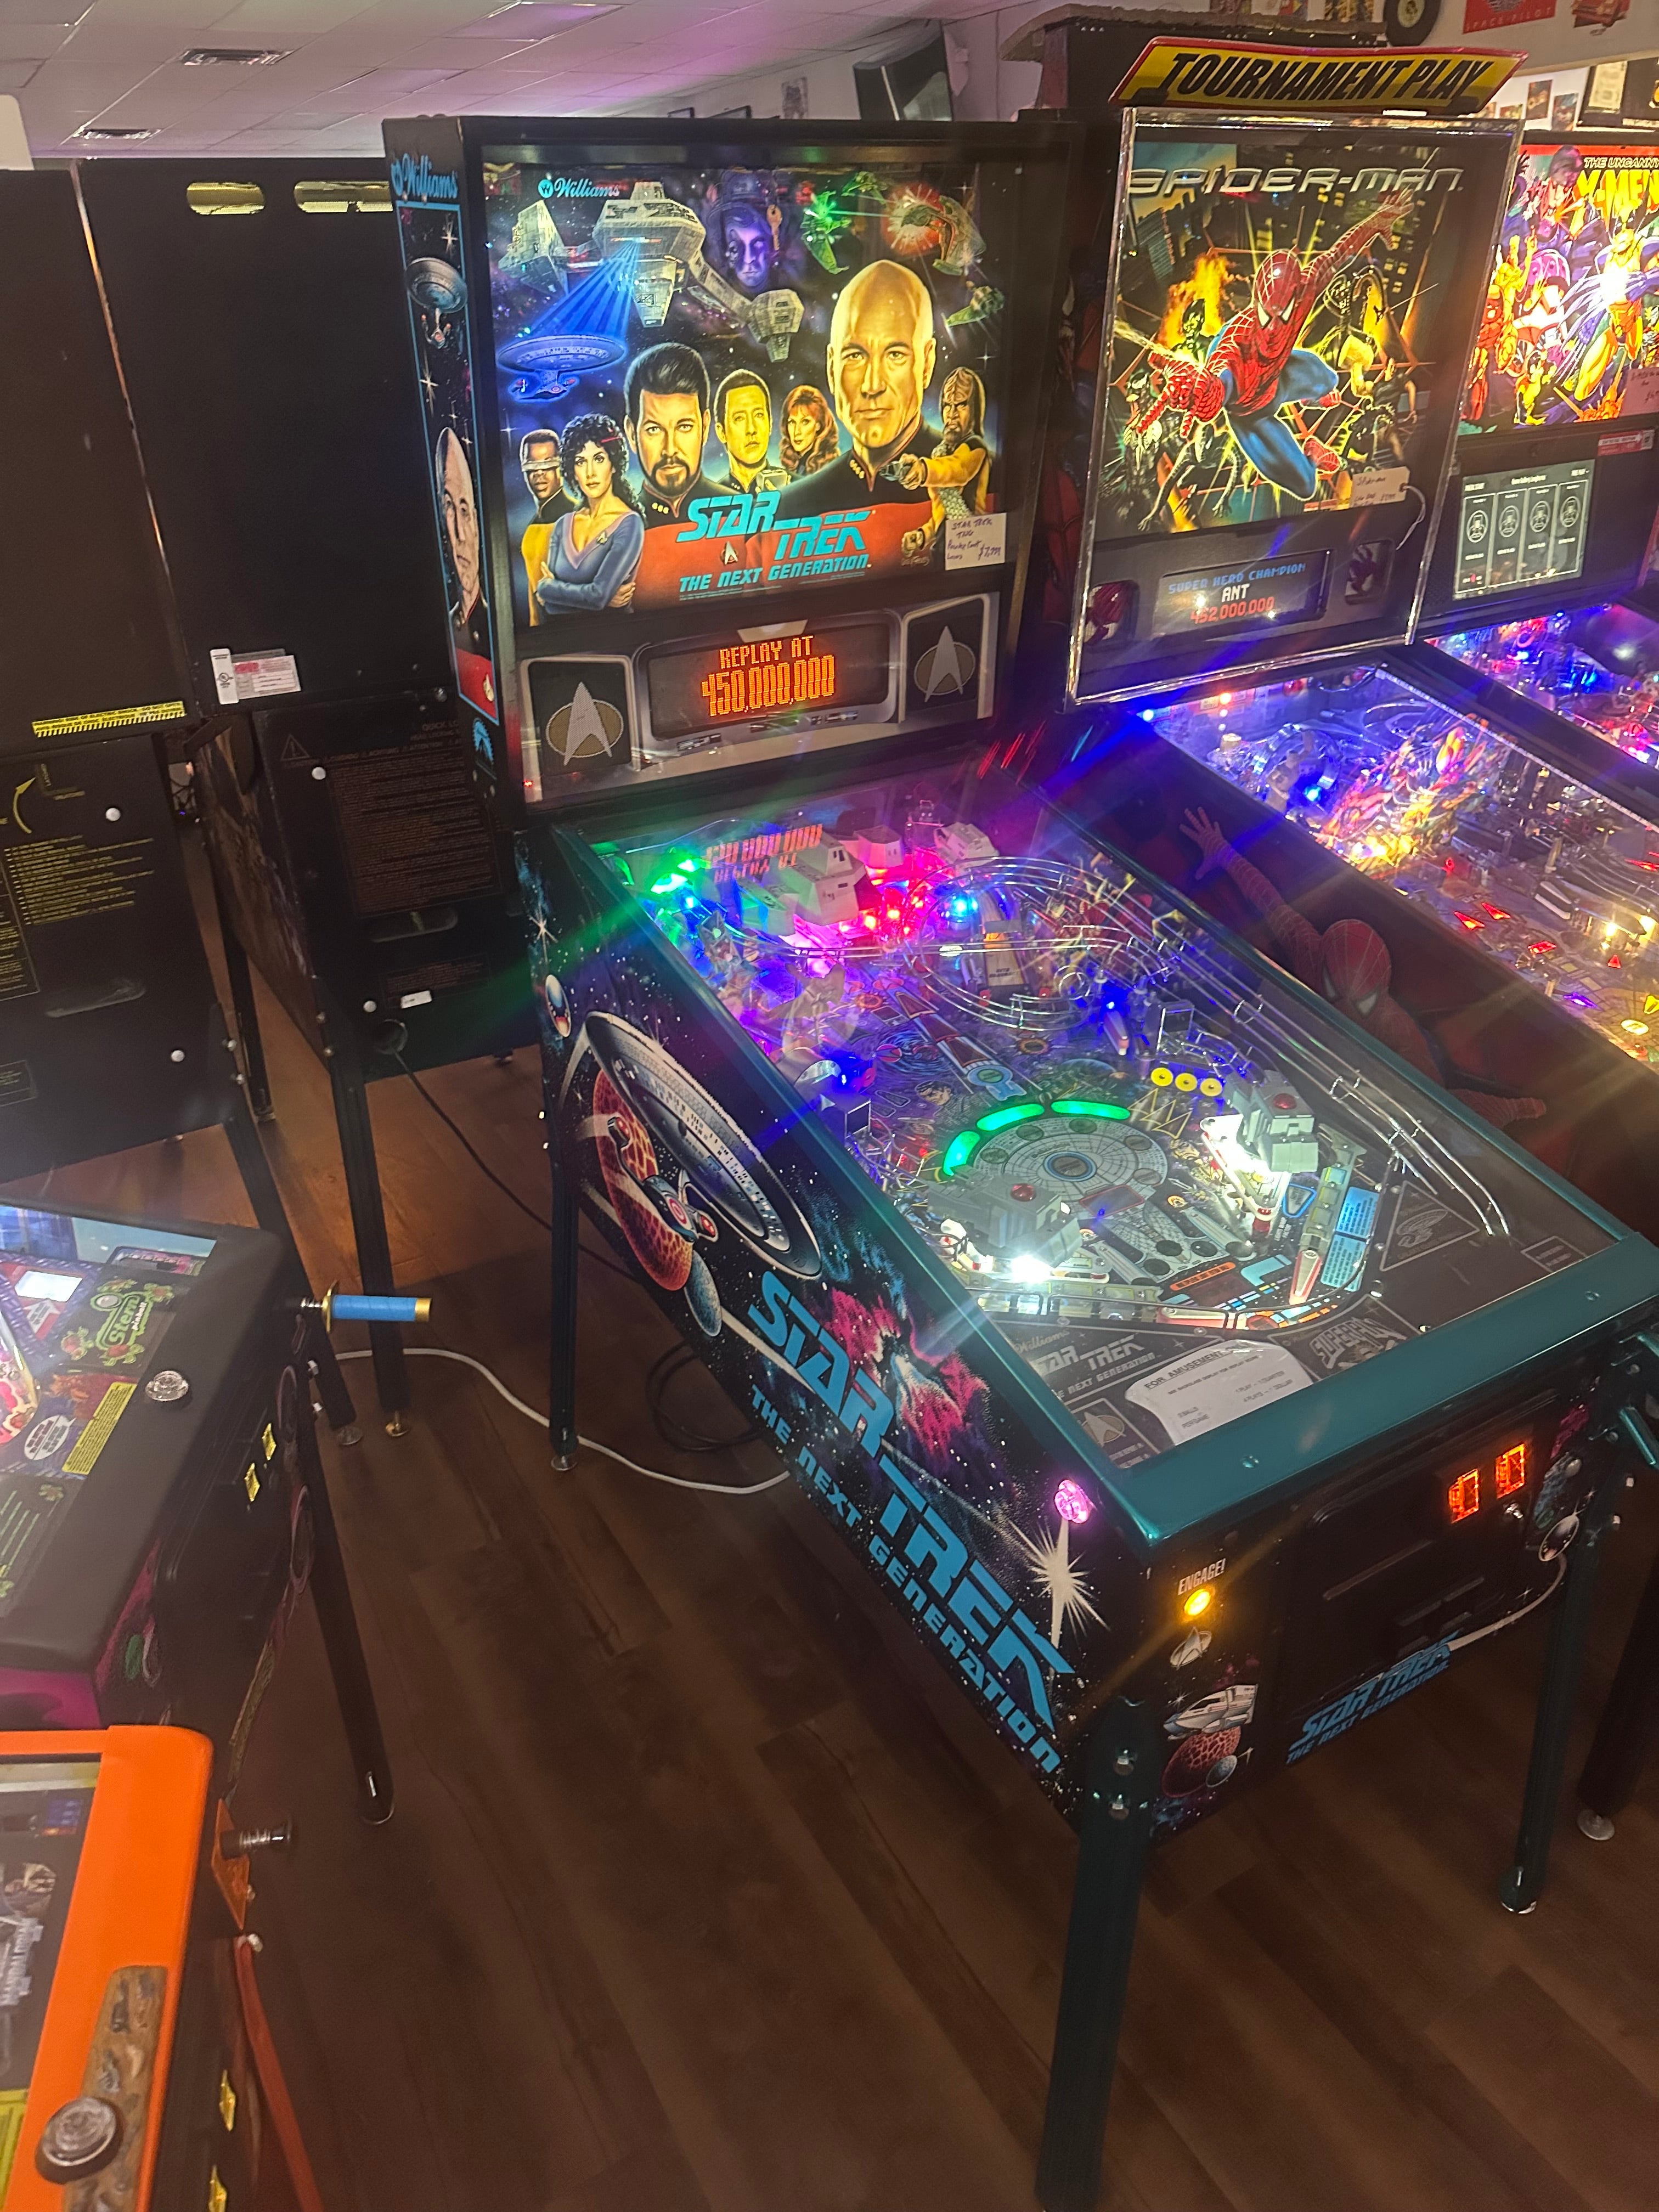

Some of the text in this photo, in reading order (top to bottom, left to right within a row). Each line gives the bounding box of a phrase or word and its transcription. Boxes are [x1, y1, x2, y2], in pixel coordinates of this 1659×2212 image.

[1165, 53, 1494, 101] TOURNAMENT PLAY
[402, 153, 459, 198] Williams
[1129, 168, 1461, 194] SPIDER-MAN
[1583, 157, 1608, 168] THE
[555, 178, 619, 198] Williams
[676, 490, 781, 543] STAR
[772, 510, 871, 561] TREK
[679, 574, 712, 592] THE
[717, 567, 763, 588] NEXT
[768, 554, 869, 580] GENERATION
[1168, 562, 1306, 594] SUPER HERO CHAMPION
[1221, 583, 1251, 602] ANT
[720, 635, 814, 669] REPLAY AT
[701, 654, 835, 716] 450,000,000
[109, 1298, 139, 1345] Stern
[1310, 1317, 1408, 1369] SUPERPIN
[747, 1271, 895, 1457] STAR
[1030, 1345, 1080, 1375] TAR
[1068, 1352, 1155, 1395] NEXT GENERATION
[1079, 1335, 1145, 1370] TREK
[1144, 1376, 1166, 1390] FOR
[1169, 1351, 1223, 1378] AMUSEMENT
[752, 1384, 1061, 1774] THE NEXT GENERATION
[879, 1454, 1075, 1731] TREK
[1178, 1558, 1226, 1595] ENGAGE!
[1286, 1660, 1449, 1764] THE NEXT GENERATION
[1289, 1677, 1380, 1751] STAR
